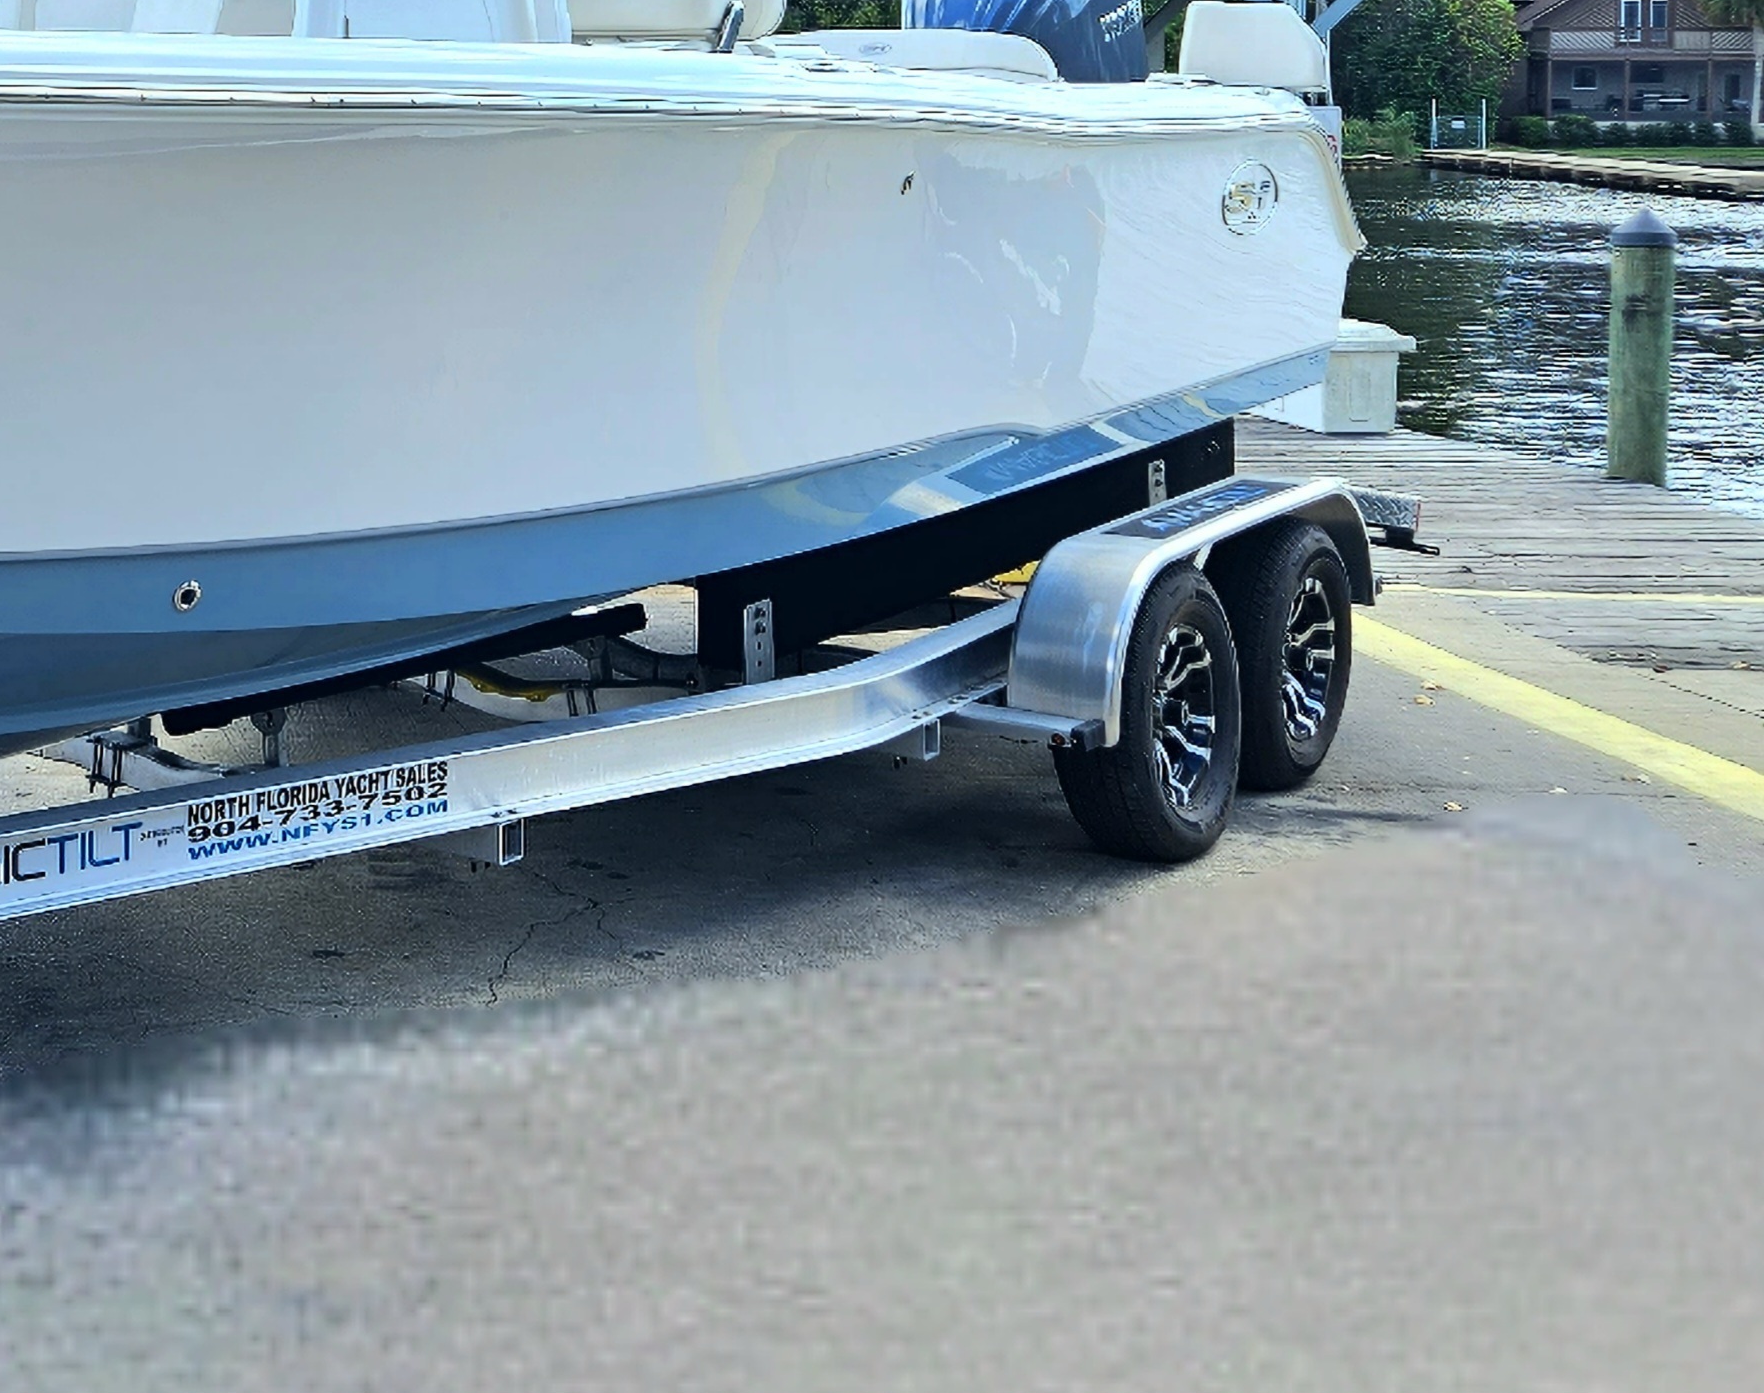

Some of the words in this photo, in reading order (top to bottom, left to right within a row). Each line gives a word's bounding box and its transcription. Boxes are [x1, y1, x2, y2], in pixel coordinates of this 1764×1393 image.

[187, 794, 250, 827] NORTH
[255, 780, 330, 813] FLORIDA
[334, 769, 392, 799] YACHT
[395, 760, 448, 788] SALES
[187, 782, 448, 843] 904-733-7502
[187, 799, 448, 860] WWW.NFYS1.COM
